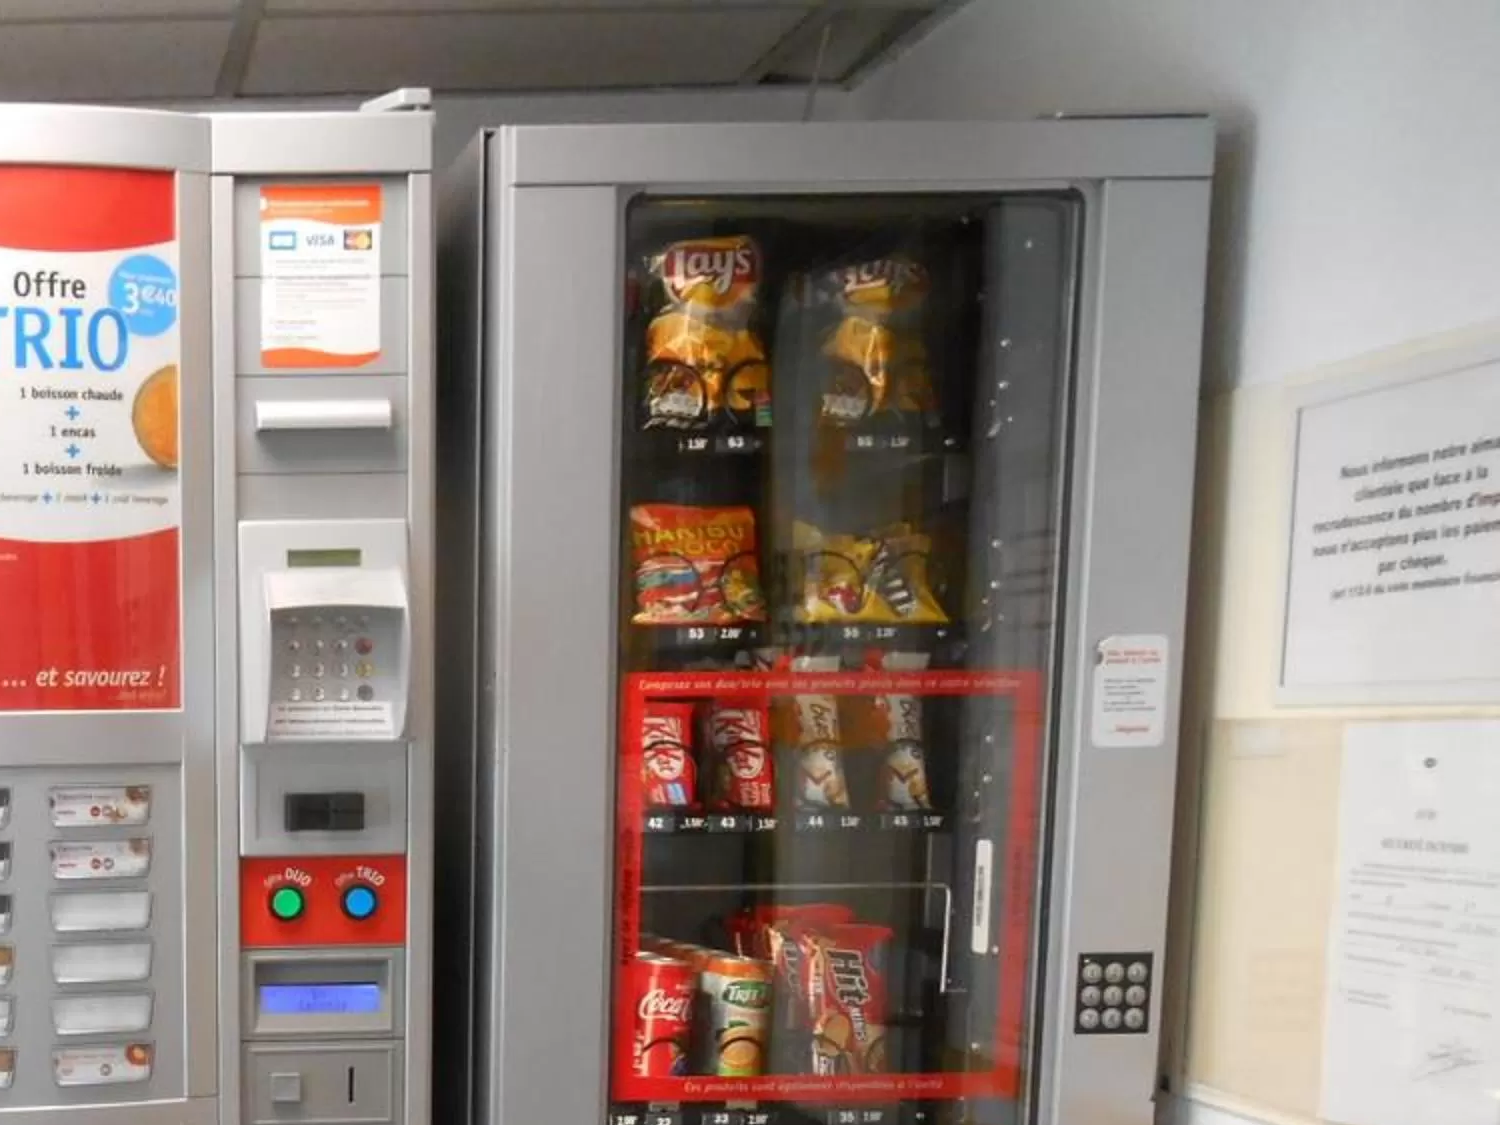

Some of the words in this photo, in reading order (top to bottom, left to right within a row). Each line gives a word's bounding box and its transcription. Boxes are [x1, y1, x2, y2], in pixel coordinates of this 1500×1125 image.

[306, 235, 335, 247] VISA
[13, 271, 86, 301] Offre
[20, 387, 26, 399] 1
[31, 386, 78, 400] boisson
[81, 388, 124, 401] chaude
[61, 426, 96, 438] encas
[23, 463, 29, 475] 1
[34, 463, 81, 475] boisson
[86, 463, 123, 477] froide
[1433, 471, 1461, 486] face
[1476, 466, 1488, 479] la
[1398, 506, 1412, 518] du
[1415, 500, 1461, 515] nombre
[1412, 529, 1437, 544] plus
[1441, 525, 1460, 538] les
[1378, 561, 1397, 576] par
[36, 667, 59, 687] et
[63, 669, 151, 687] savourez
[285, 867, 312, 887] DUO
[356, 865, 385, 886] TRIO
